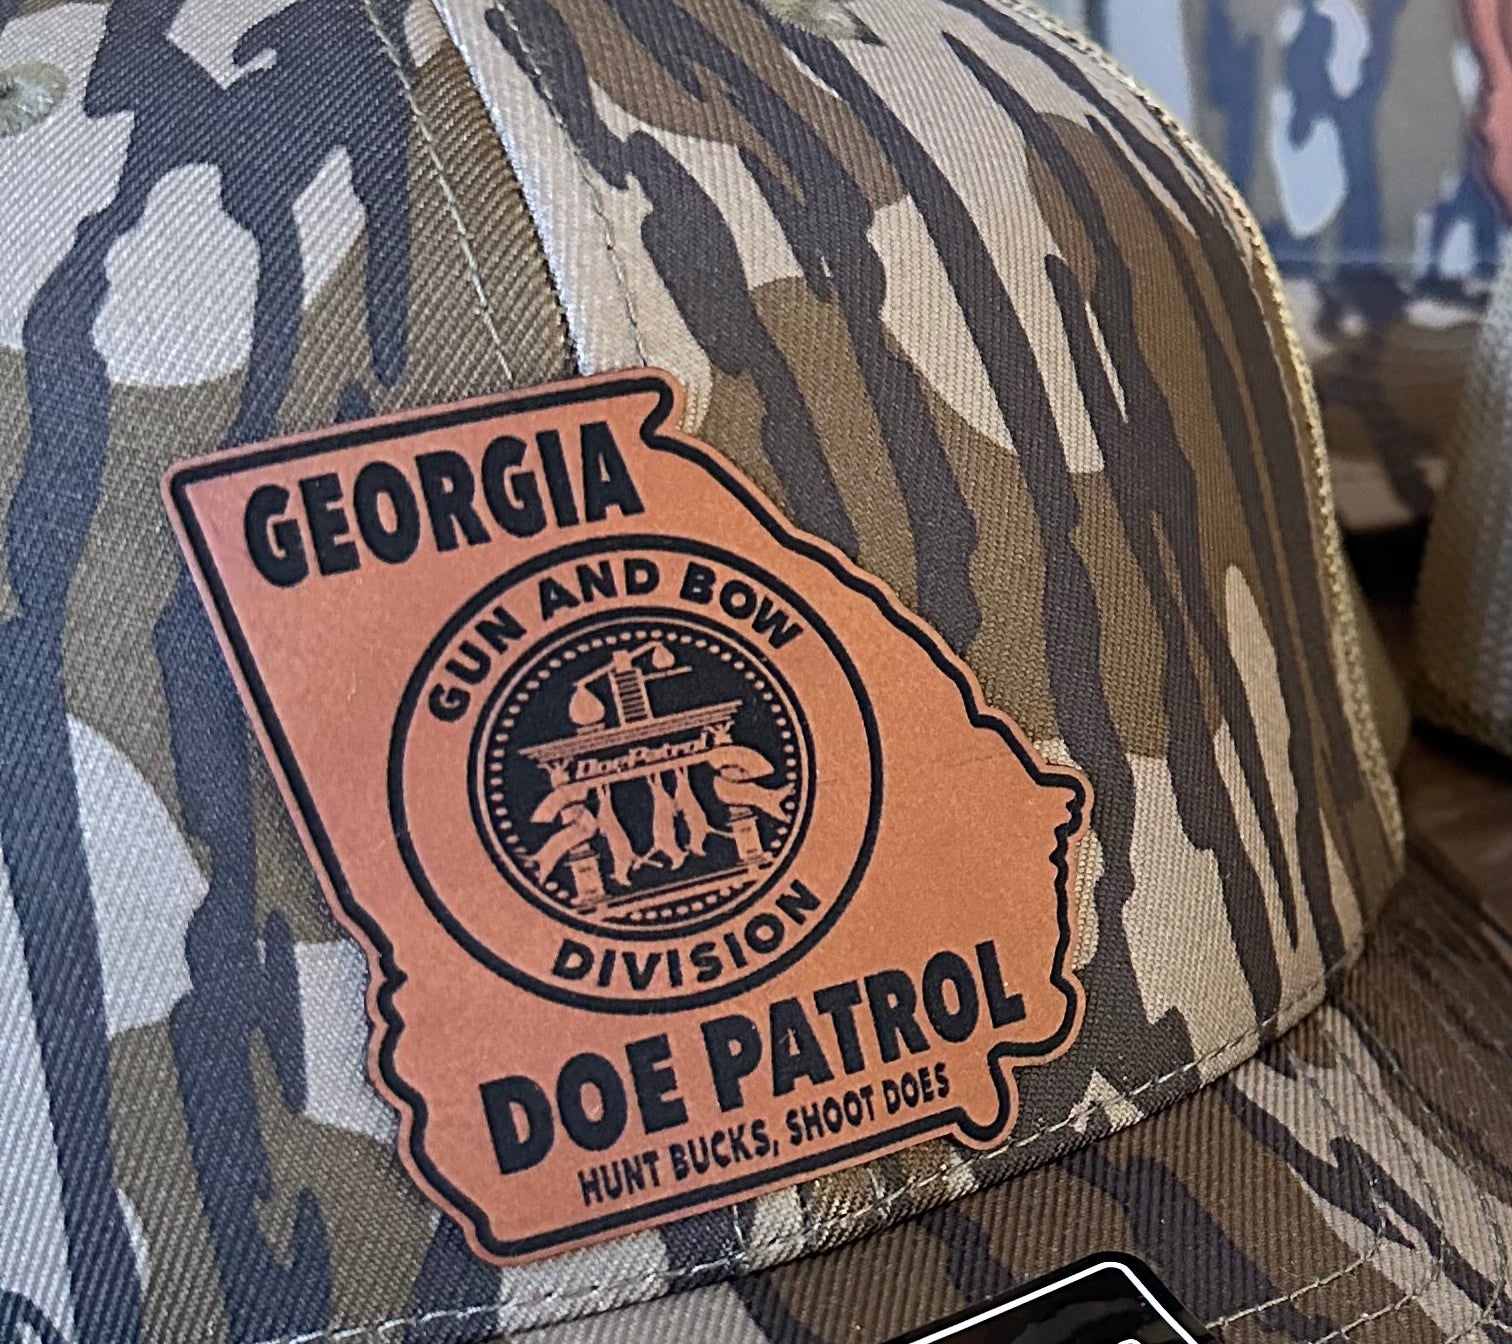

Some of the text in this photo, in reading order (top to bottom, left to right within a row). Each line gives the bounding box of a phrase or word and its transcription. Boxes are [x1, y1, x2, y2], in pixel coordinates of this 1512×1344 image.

[244, 420, 645, 587] GEORGIA
[428, 557, 804, 723] GUN AND BOW
[552, 879, 821, 990] DIVISION
[479, 939, 1026, 1176] DOE PATROL
[579, 1063, 951, 1207] HUNT BUCKS, SHOOT DOES
